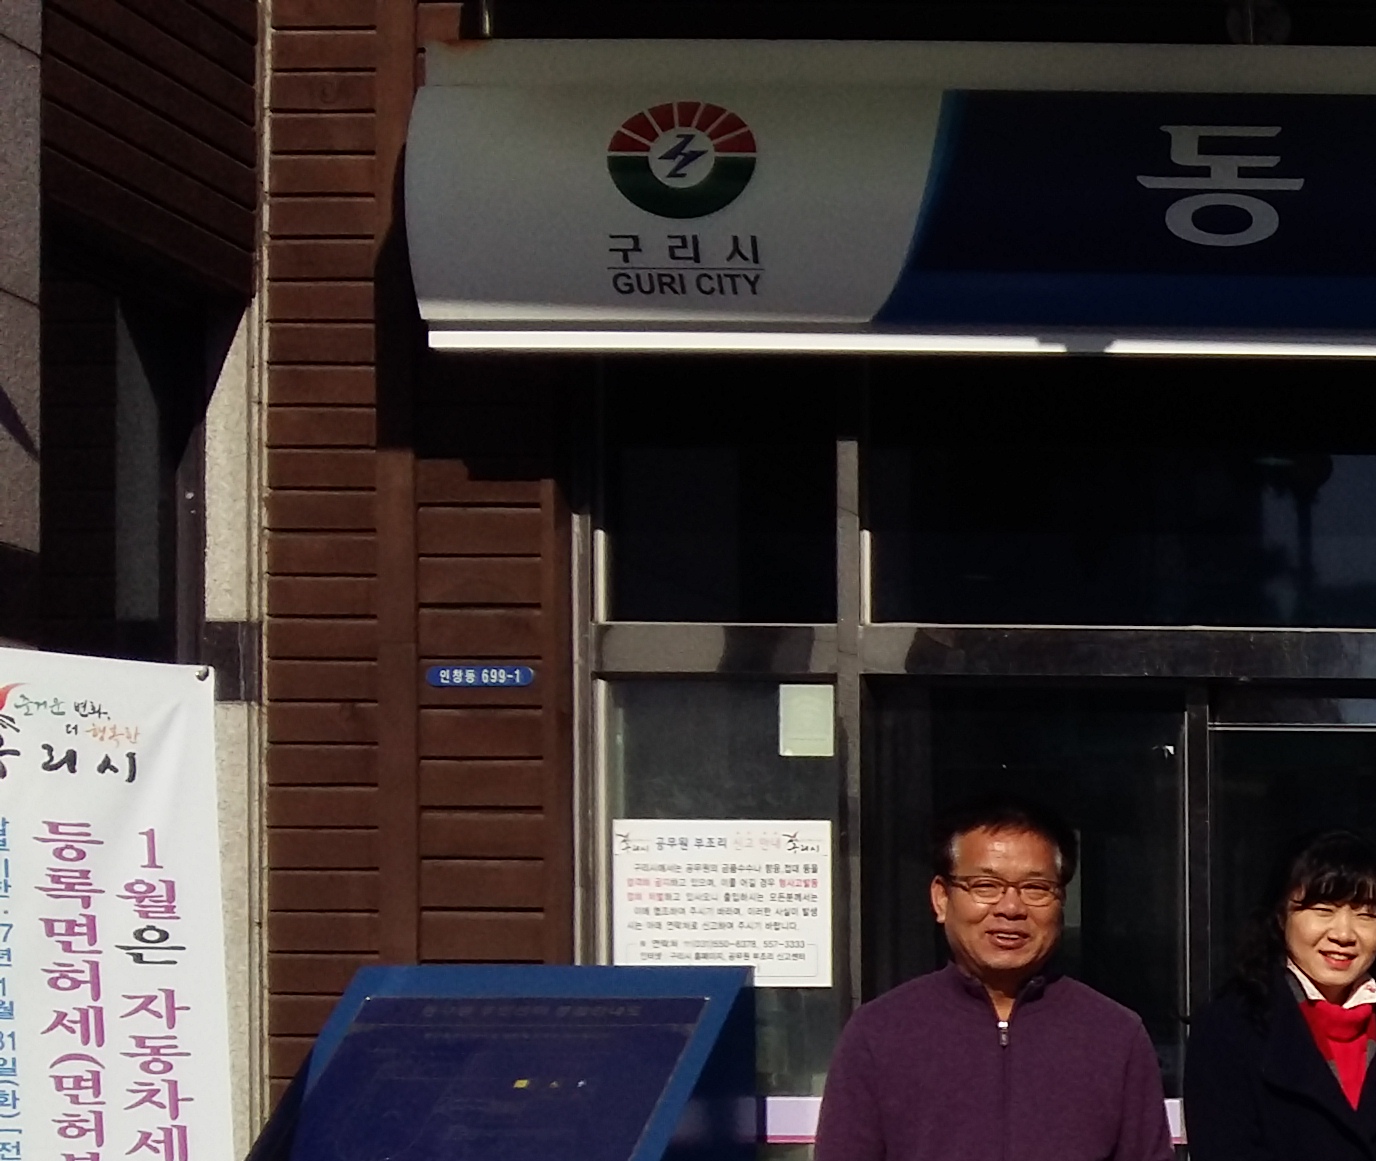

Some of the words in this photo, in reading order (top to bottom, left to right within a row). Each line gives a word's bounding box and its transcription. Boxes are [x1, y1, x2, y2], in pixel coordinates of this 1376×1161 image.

[608, 233, 760, 265] 구리시
[611, 272, 687, 296] GURI
[695, 272, 761, 296] CITY
[482, 669, 520, 683] 699-1
[14, 694, 66, 716] 즐거운
[114, 827, 189, 968] 1월은
